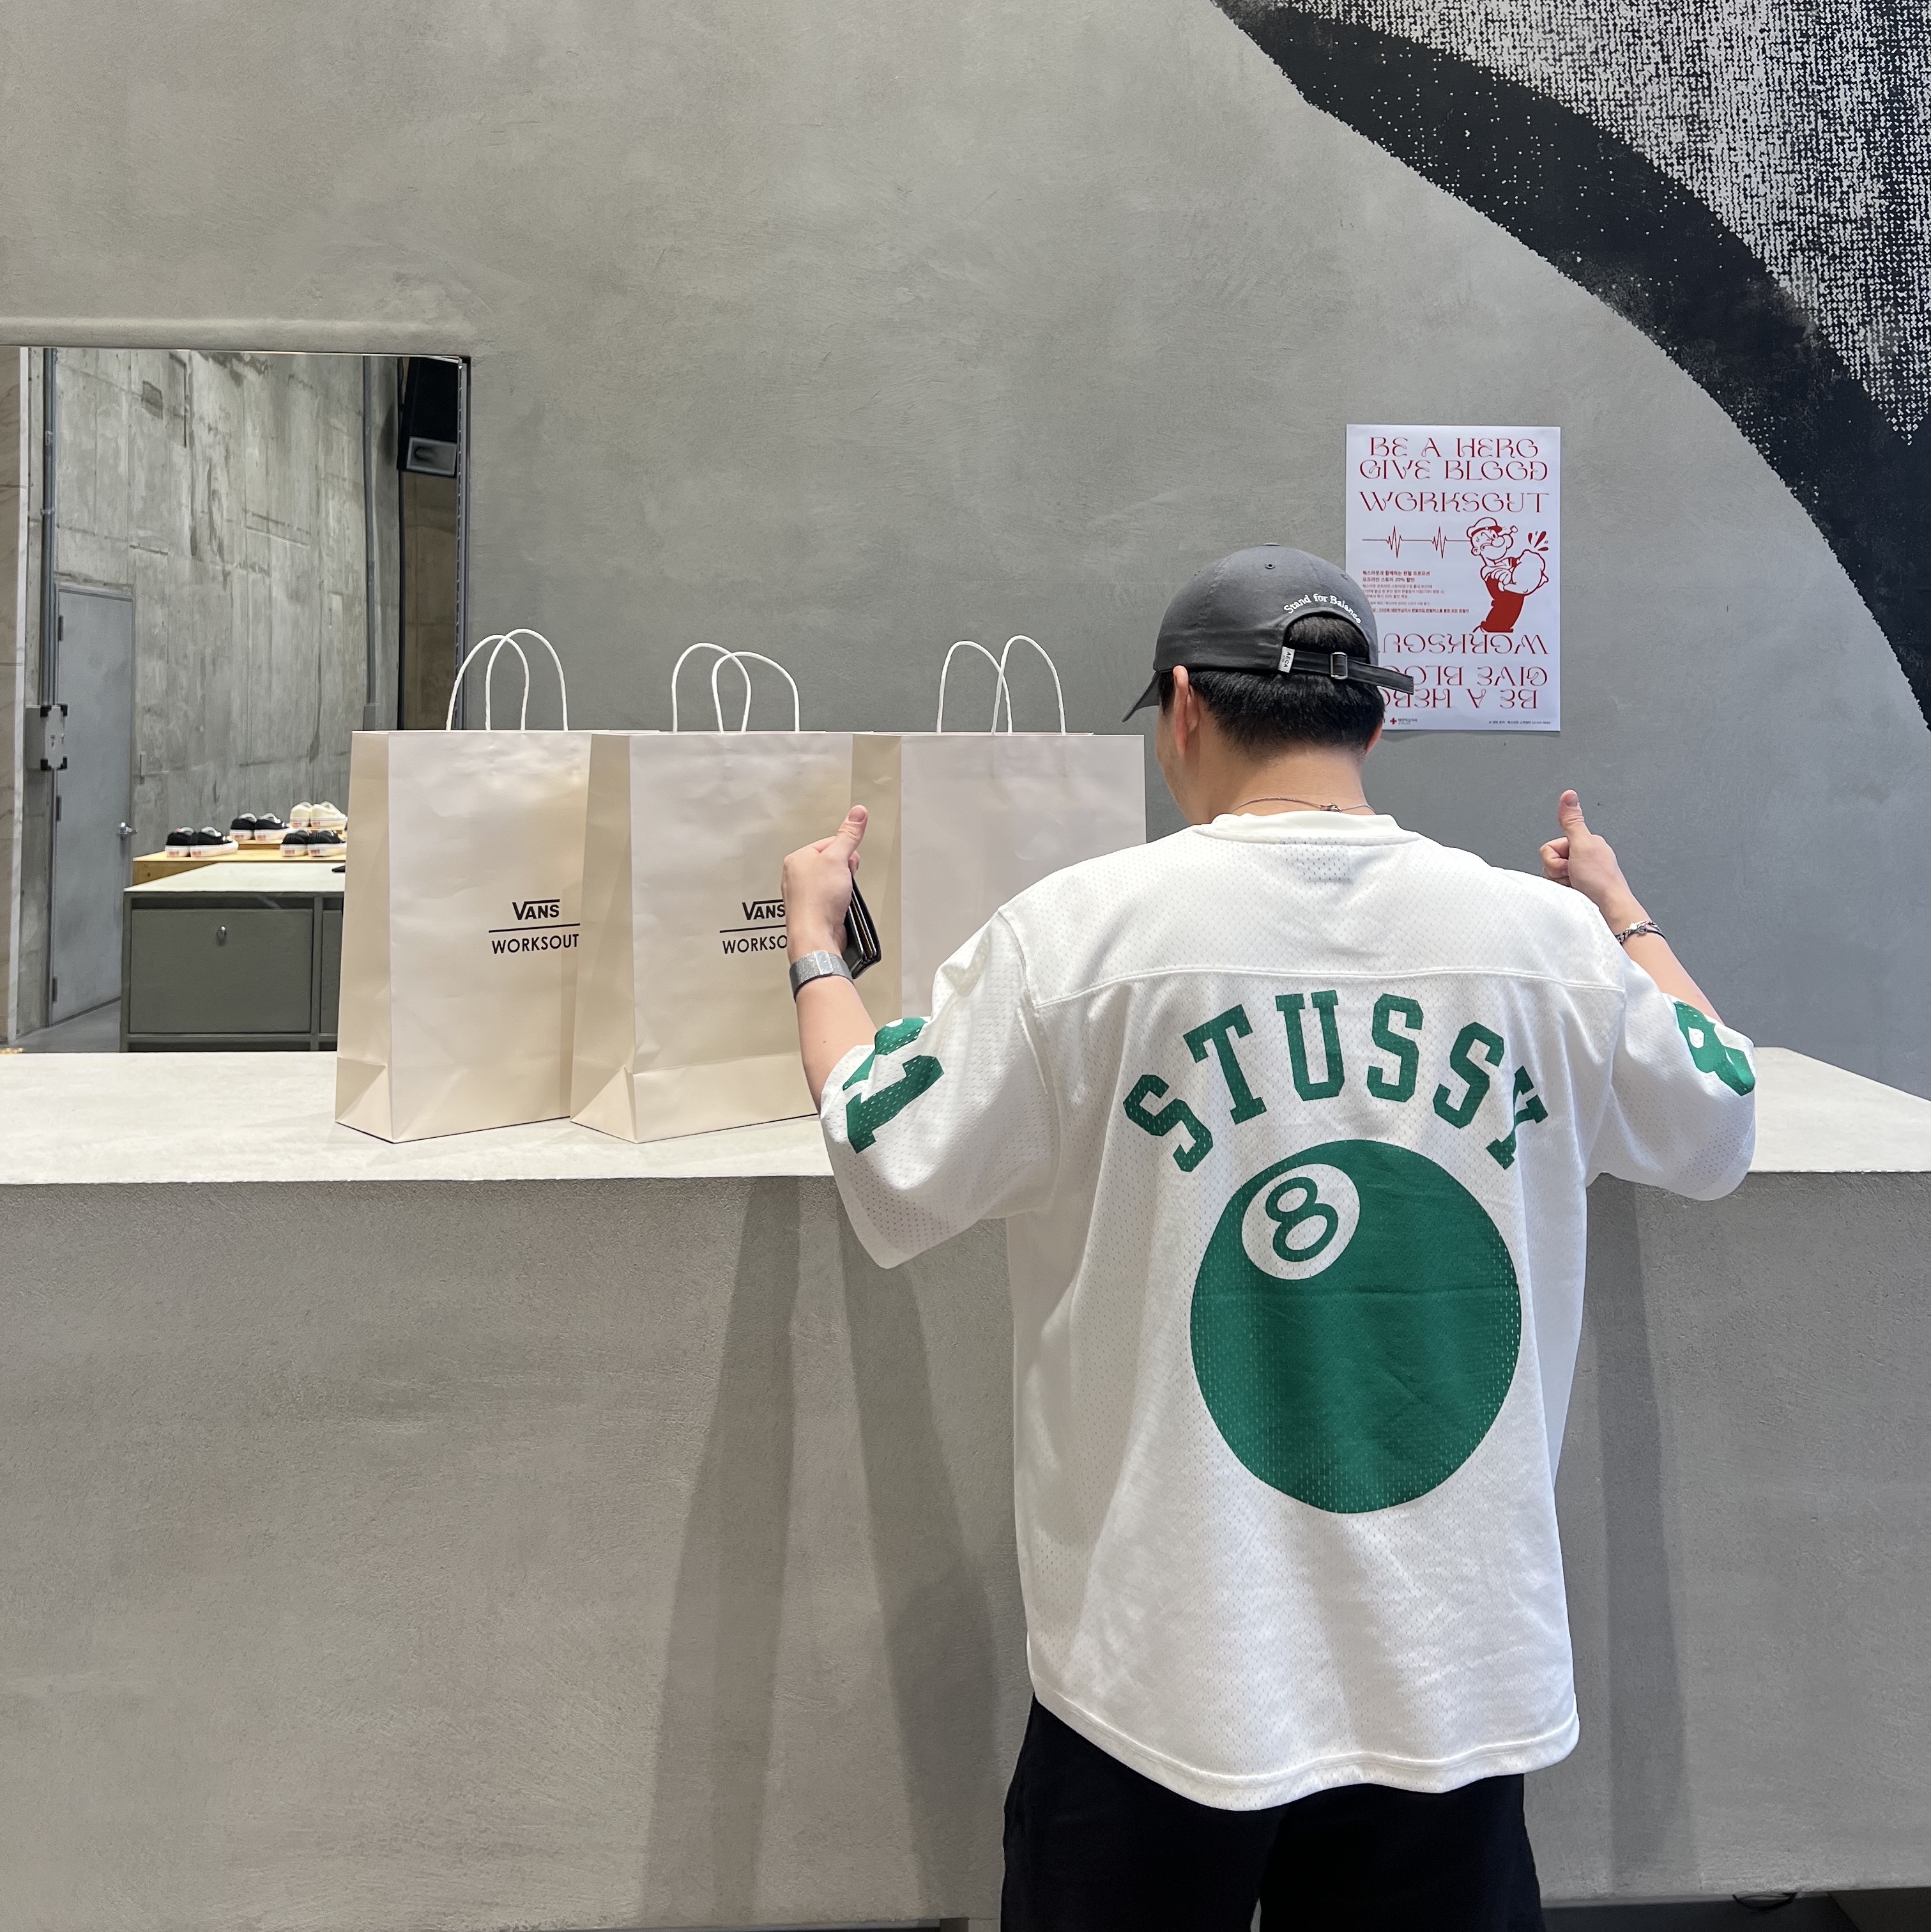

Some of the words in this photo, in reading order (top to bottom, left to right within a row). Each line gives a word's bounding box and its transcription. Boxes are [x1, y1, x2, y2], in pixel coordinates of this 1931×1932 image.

[1370, 436, 1408, 458] BE
[1421, 437, 1442, 458] A
[1456, 437, 1539, 459] HERO
[1359, 459, 1431, 480] GIVE
[1444, 460, 1548, 482] BLOOD
[1359, 491, 1550, 513] WORKSOUT
[1283, 595, 1311, 614] Stand
[1313, 593, 1329, 603] for
[1329, 595, 1362, 624] Balance
[1378, 632, 1549, 654] WORKSOU
[1477, 665, 1548, 686] GIVE
[1467, 689, 1488, 709] A
[1500, 689, 1538, 709] BE
[512, 899, 560, 921] VANS
[742, 899, 786, 921] VANS
[491, 933, 579, 954] WORKSOUT
[722, 935, 788, 954] WORKSO
[1123, 990, 1548, 1173] STUSSY
[1265, 1176, 1339, 1263] 8
